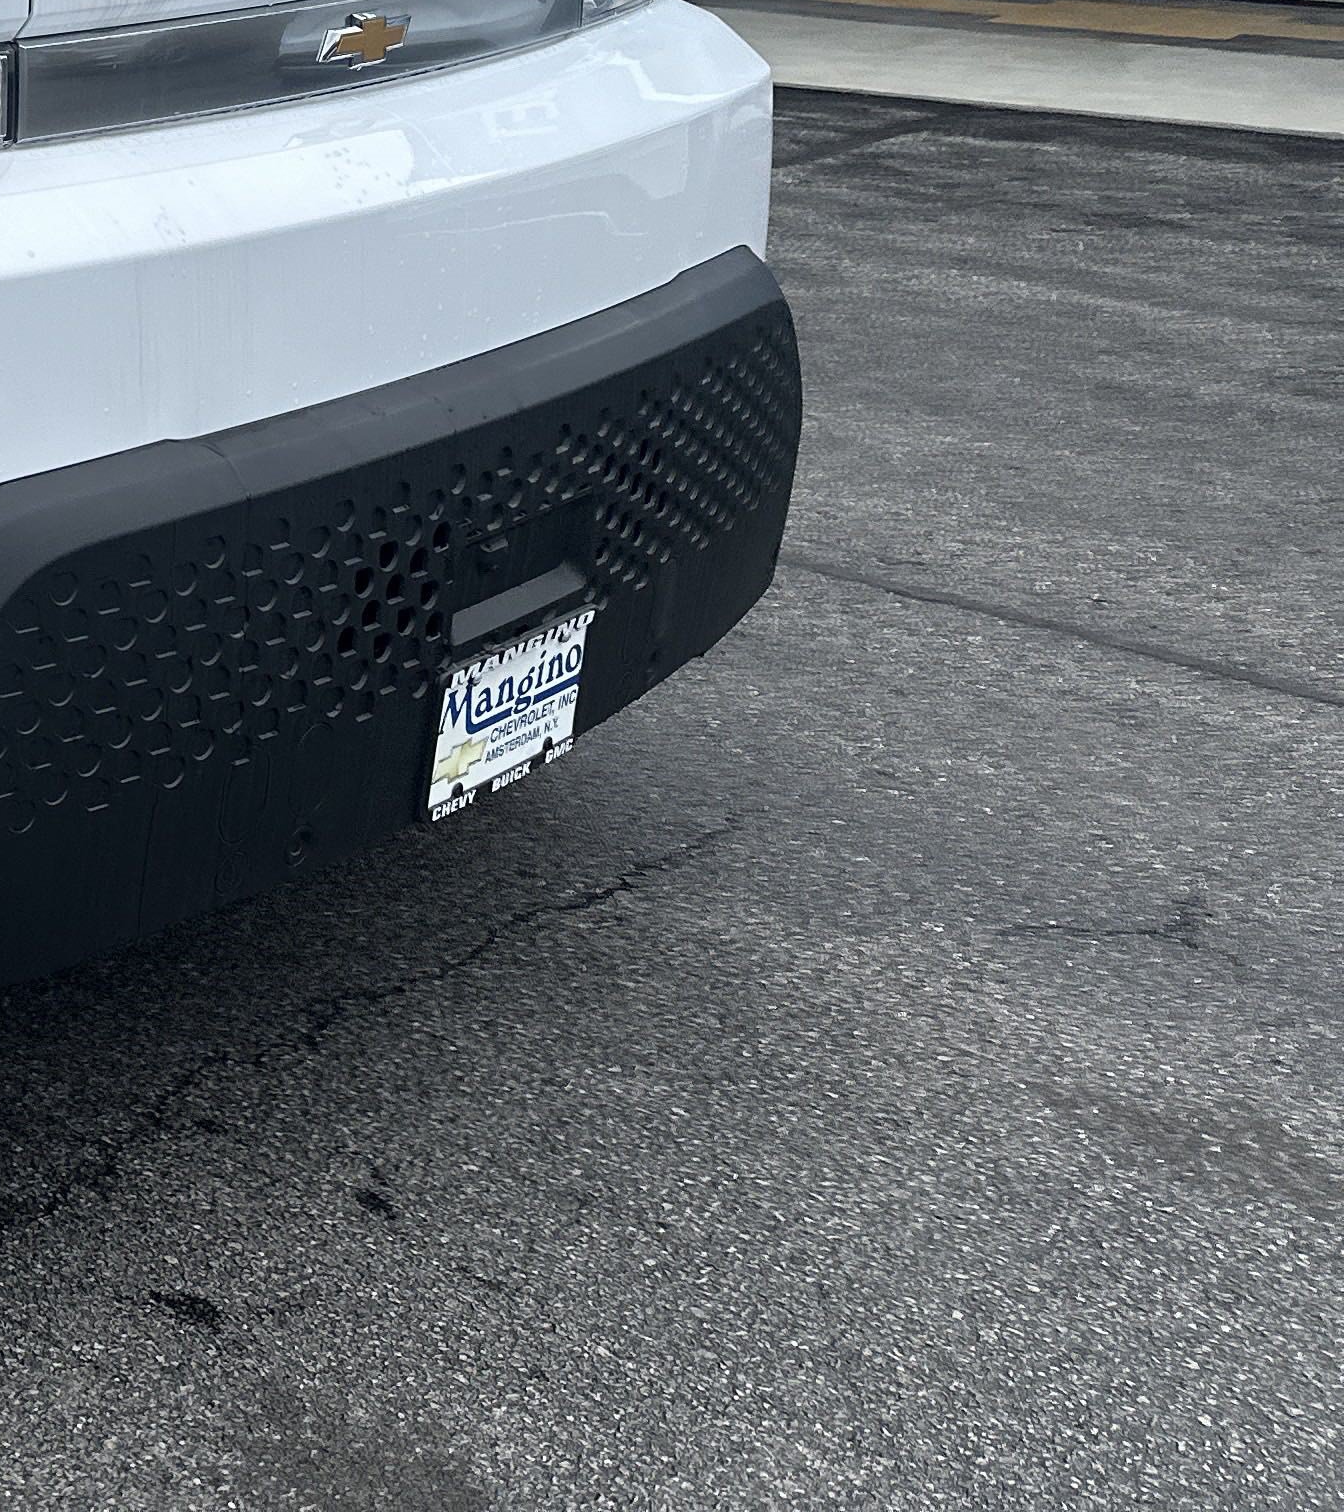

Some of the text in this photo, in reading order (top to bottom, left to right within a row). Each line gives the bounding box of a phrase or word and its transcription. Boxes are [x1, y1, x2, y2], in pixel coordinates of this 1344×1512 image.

[439, 643, 583, 734] Mangino
[450, 609, 596, 689] MANGINO
[431, 737, 574, 822] CHEVY BUICK GMC
